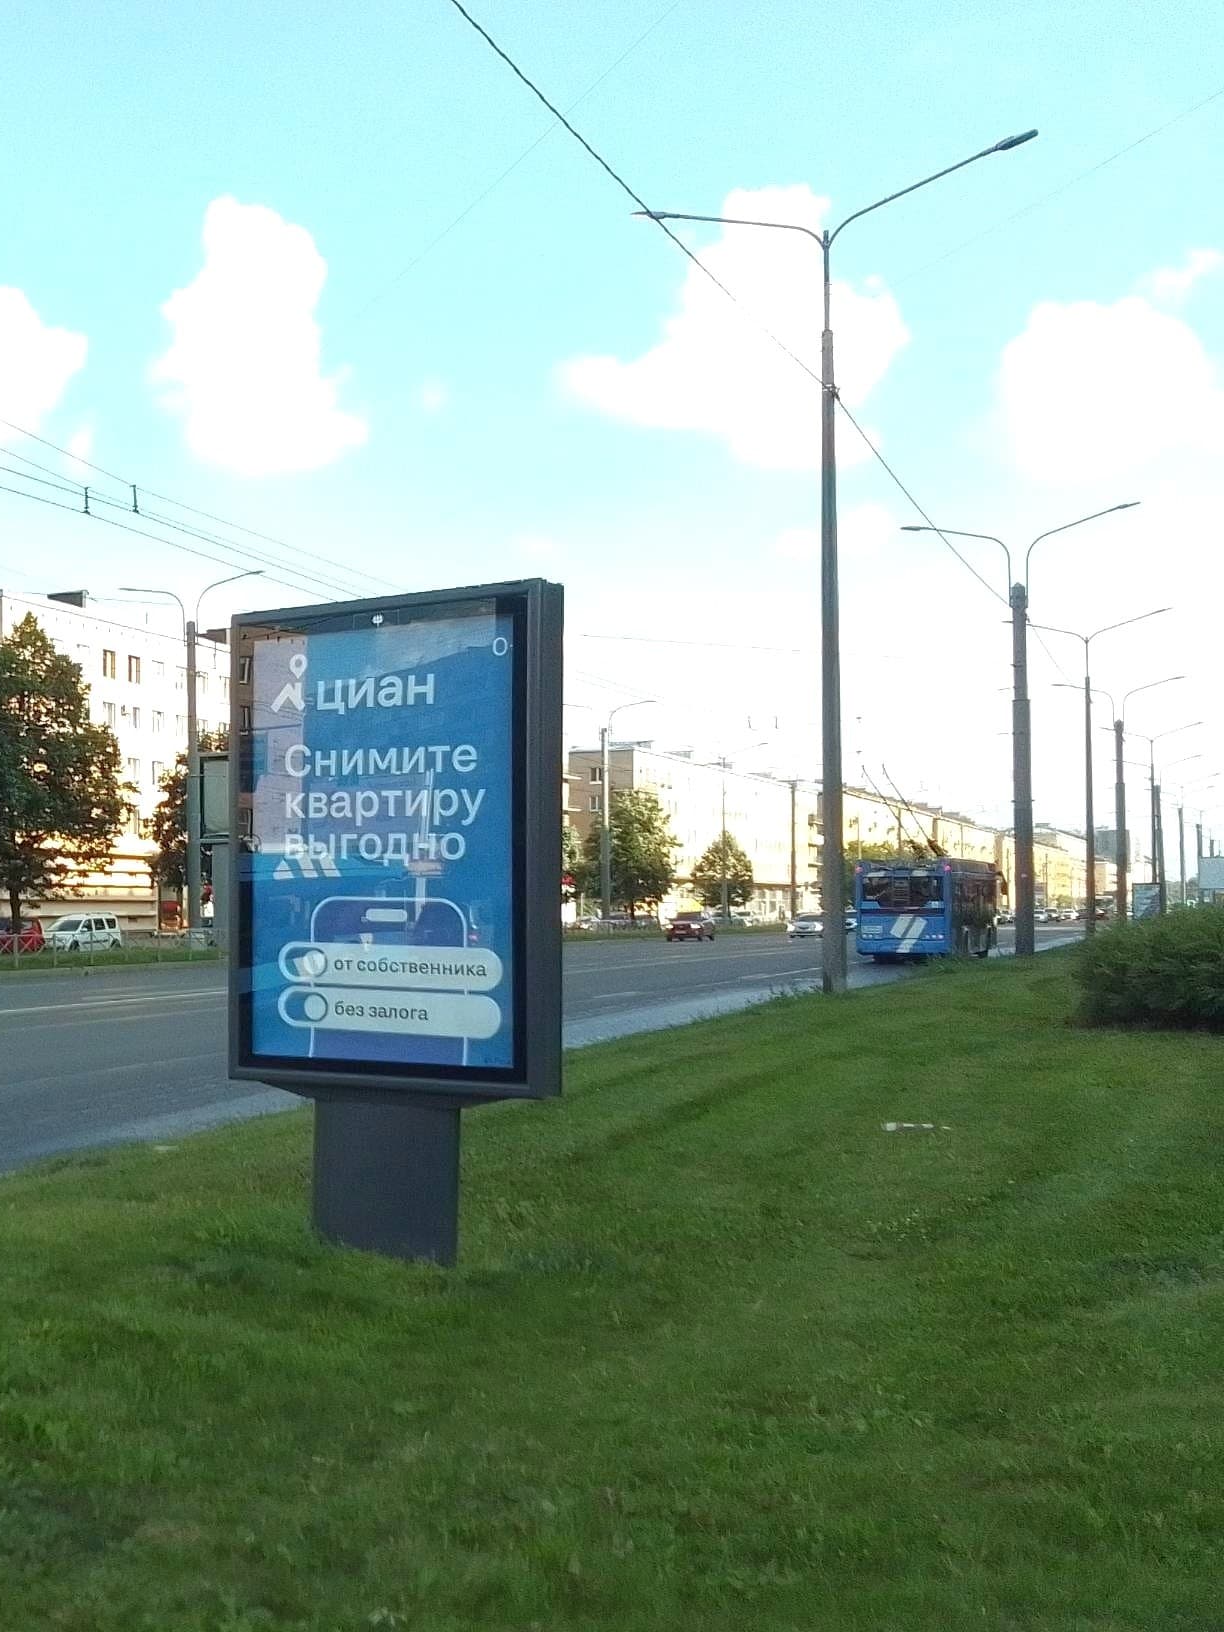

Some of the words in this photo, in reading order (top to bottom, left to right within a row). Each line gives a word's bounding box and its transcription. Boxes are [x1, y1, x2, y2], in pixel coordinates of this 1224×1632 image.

[316, 673, 435, 715] циан
[284, 744, 477, 778] Снимите
[285, 788, 486, 826] квартиру
[284, 832, 465, 866] выгодно
[334, 959, 353, 971] от
[356, 957, 487, 977] собственника
[334, 1001, 364, 1017] без
[368, 1004, 428, 1021] залога
